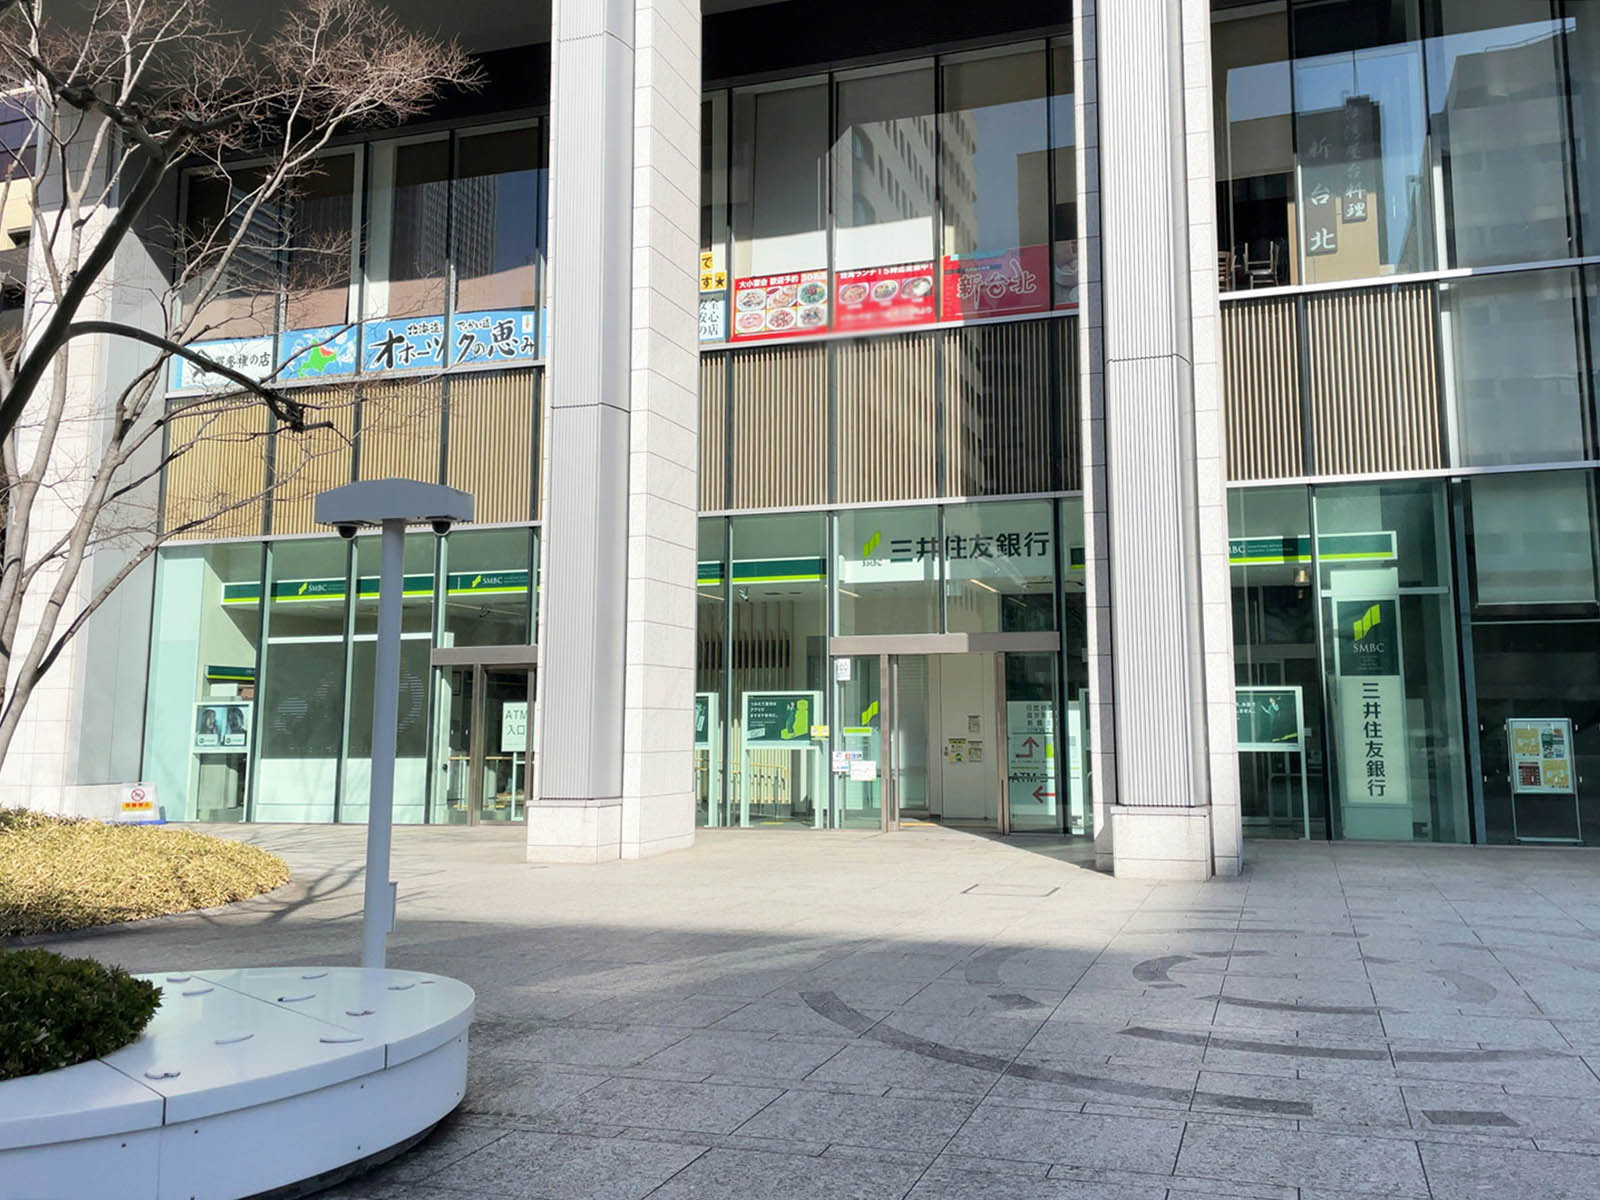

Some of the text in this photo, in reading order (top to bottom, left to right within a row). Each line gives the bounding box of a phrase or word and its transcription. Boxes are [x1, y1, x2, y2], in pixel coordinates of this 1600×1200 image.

[369, 320, 535, 369] オホーツクの恵み
[890, 532, 1049, 563] 三井住友銀行
[1352, 642, 1385, 654] SMBC
[507, 725, 525, 736] 入口
[1362, 682, 1386, 797] 三井住友銀行
